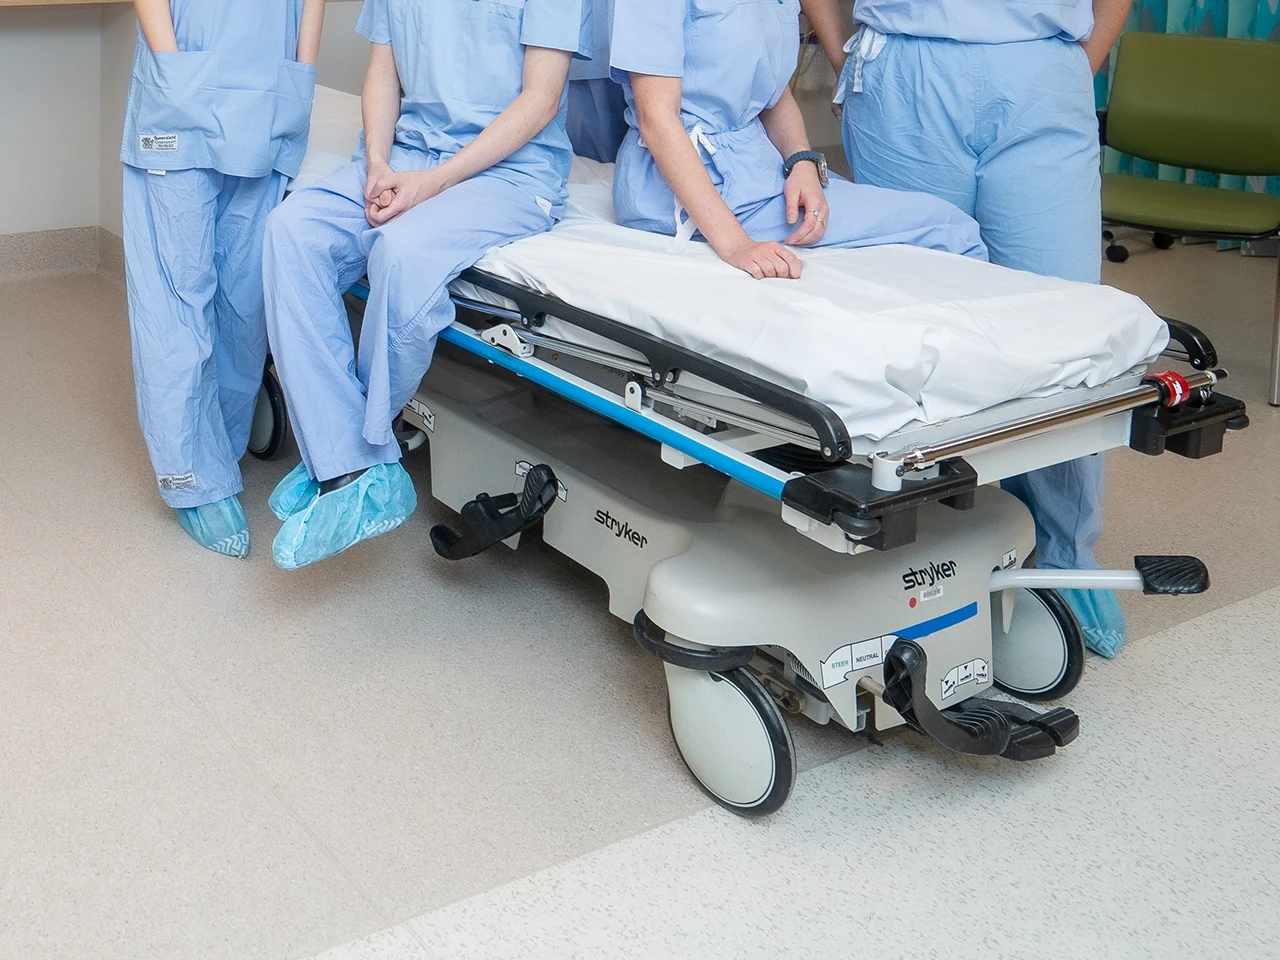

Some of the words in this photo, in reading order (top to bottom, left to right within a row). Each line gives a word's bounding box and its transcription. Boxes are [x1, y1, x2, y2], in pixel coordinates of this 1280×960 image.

[594, 509, 648, 549] stryker
[902, 560, 957, 591] stryker
[831, 659, 849, 669] STEER
[855, 651, 879, 663] NEUTRAL
